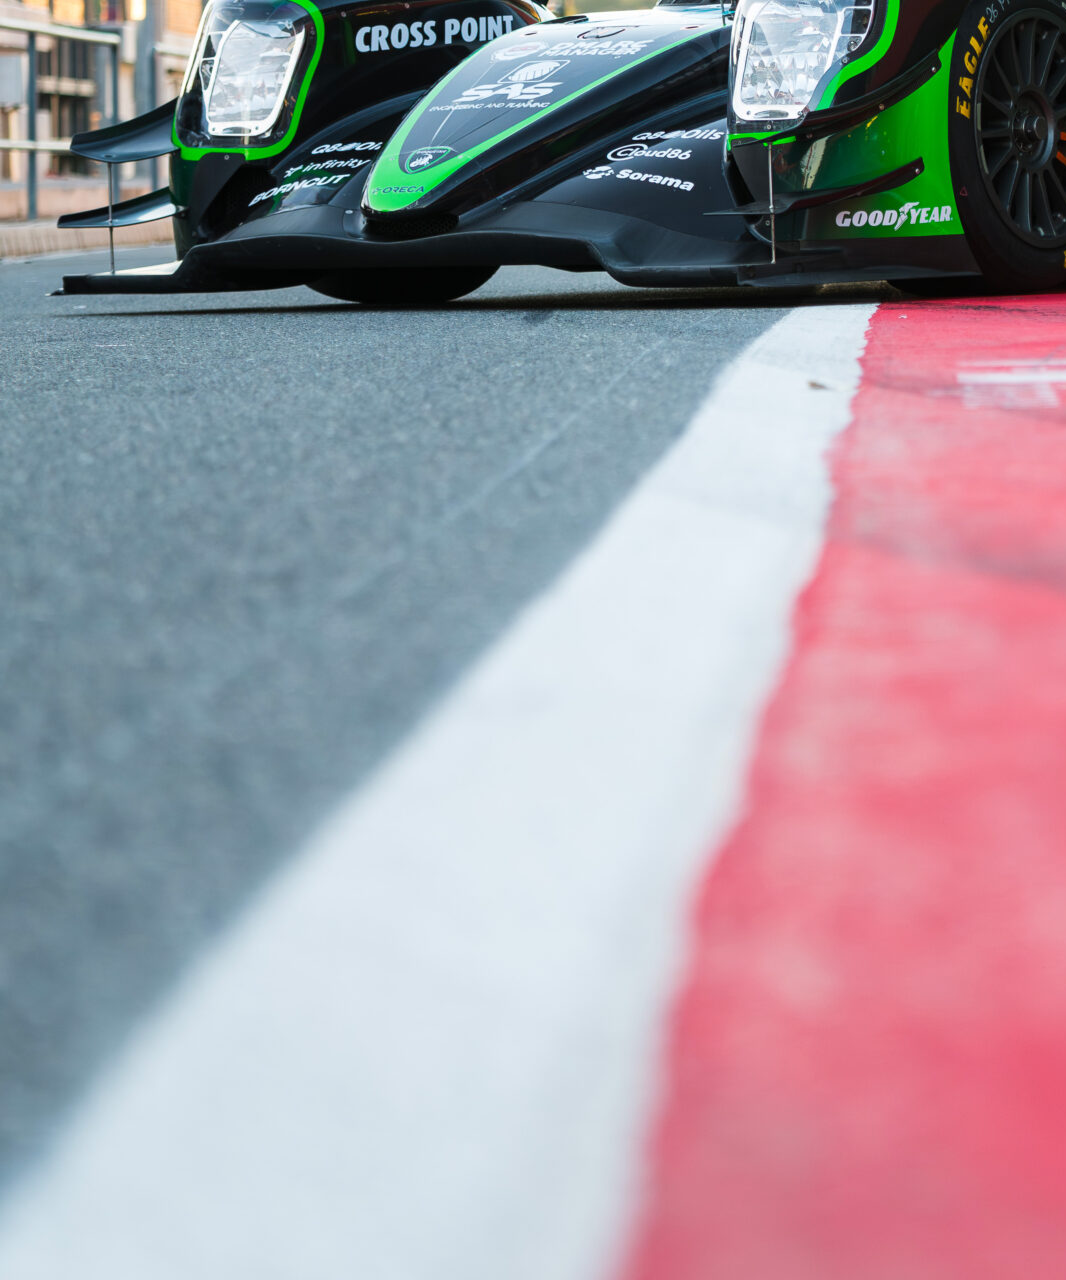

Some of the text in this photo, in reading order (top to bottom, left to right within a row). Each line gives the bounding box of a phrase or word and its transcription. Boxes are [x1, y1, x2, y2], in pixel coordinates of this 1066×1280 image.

[355, 15, 513, 53] CROSS POINT
[956, 16, 990, 119] EAGLE
[453, 82, 565, 104] SAS
[632, 129, 725, 141] Q8 Oils
[311, 143, 341, 154] Q8
[611, 147, 693, 160] Cloud86
[302, 158, 371, 173] infinity
[248, 173, 351, 207] BORNCUT
[616, 169, 695, 192] Sorama
[835, 203, 953, 230] GOODYEAR
